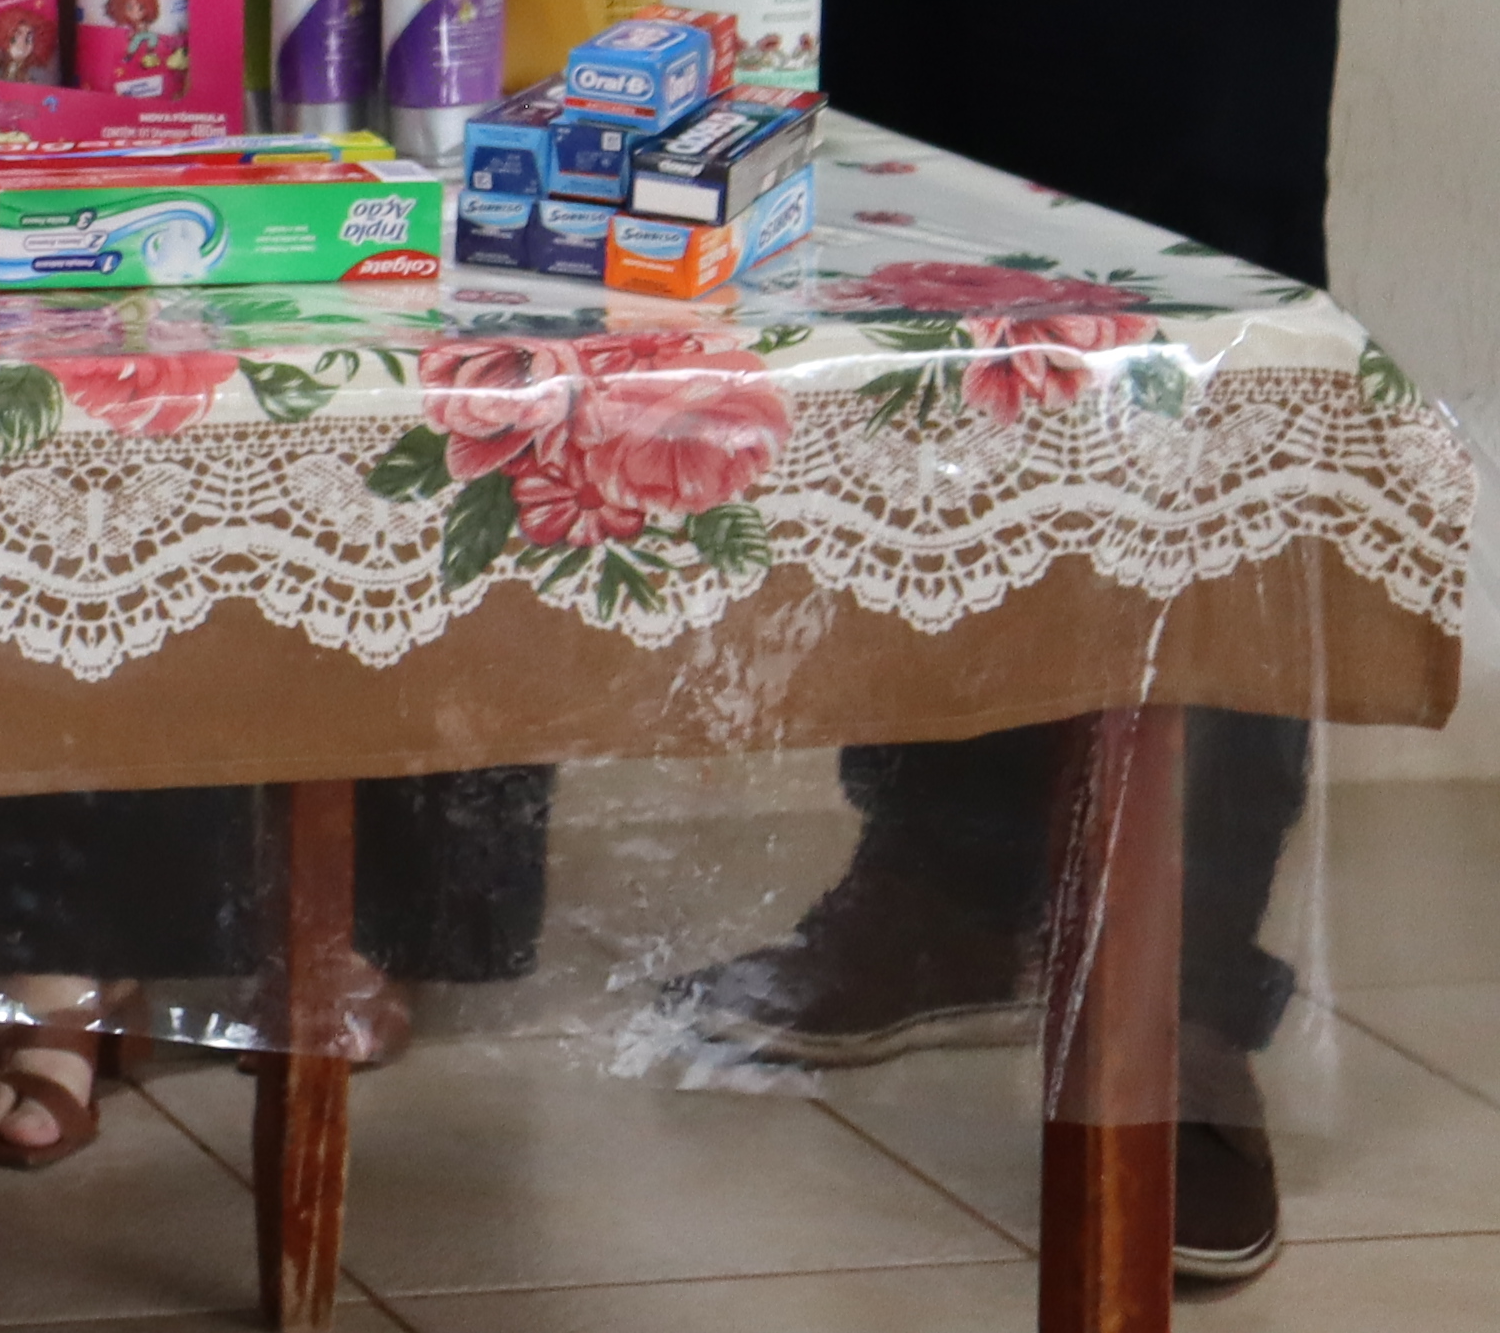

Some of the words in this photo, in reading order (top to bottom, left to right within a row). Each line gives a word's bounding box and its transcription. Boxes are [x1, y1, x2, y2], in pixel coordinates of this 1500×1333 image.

[578, 70, 648, 95] Oral-B
[350, 195, 415, 222] Ação
[462, 198, 524, 215] SORRISO
[549, 208, 607, 223] SORRISO
[77, 212, 92, 230] 3
[340, 214, 408, 244] Tripla
[622, 227, 682, 244] SORRISO
[100, 254, 114, 273] 1
[359, 255, 440, 278] Colgate
